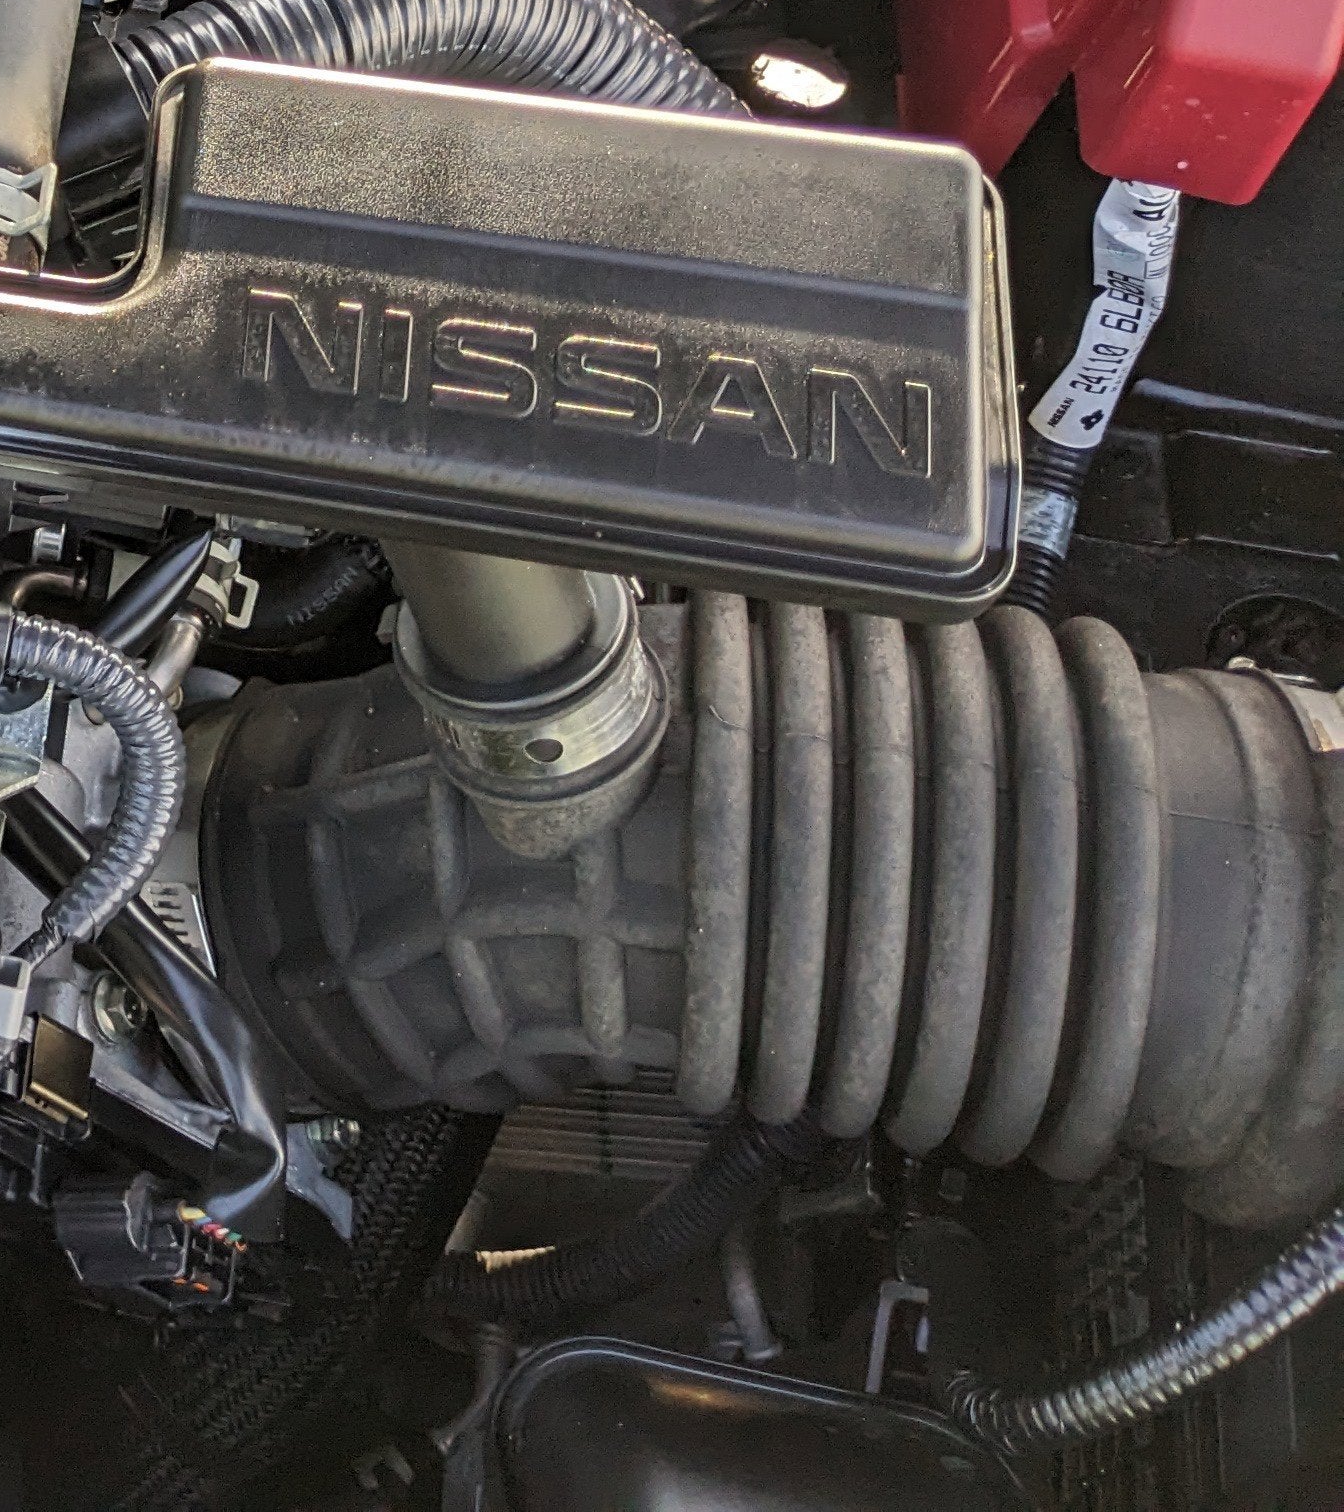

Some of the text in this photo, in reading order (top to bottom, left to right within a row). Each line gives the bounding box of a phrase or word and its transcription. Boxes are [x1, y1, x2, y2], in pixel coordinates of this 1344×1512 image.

[241, 288, 934, 480] NISSAN
[1069, 343, 1129, 396] 24110
[1048, 397, 1075, 428] NISSAN
